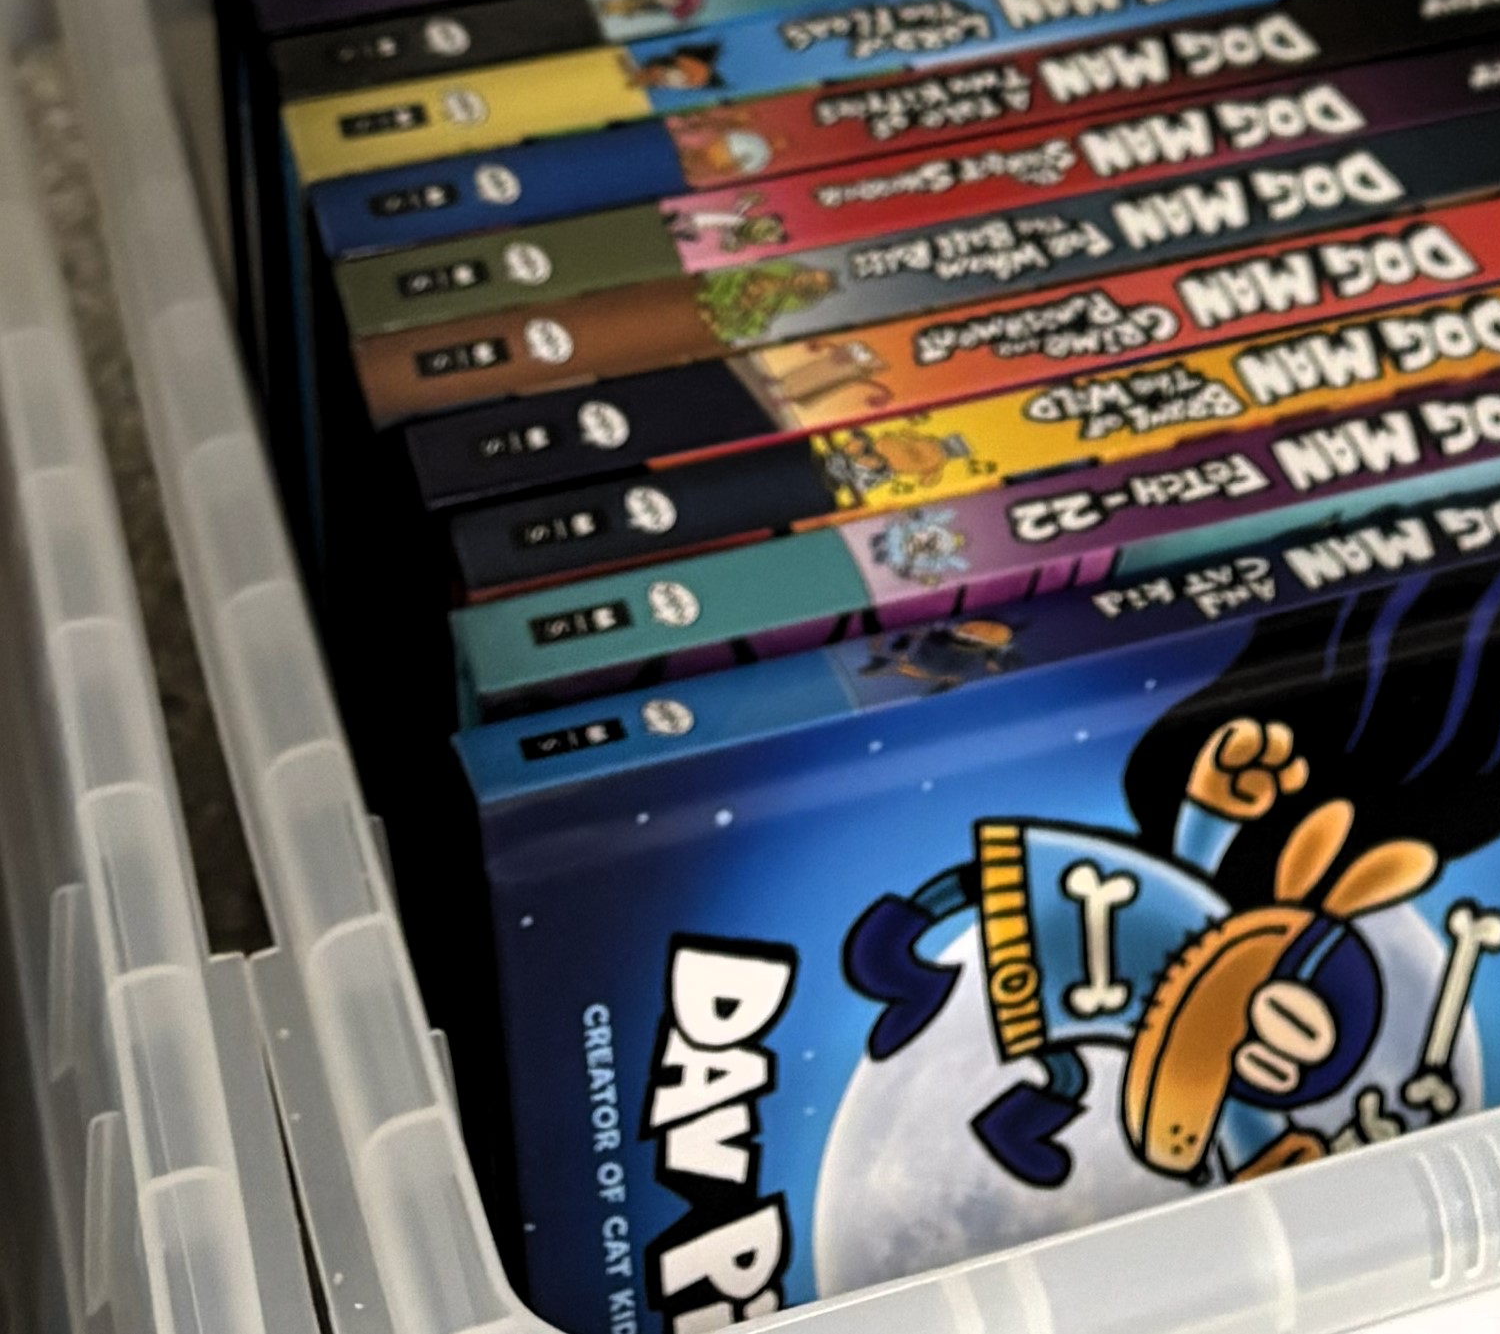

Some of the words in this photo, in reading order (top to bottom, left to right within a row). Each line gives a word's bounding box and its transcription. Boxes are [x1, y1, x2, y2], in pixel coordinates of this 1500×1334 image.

[1036, 37, 1171, 104] MAN
[1173, 12, 1322, 76] DOG
[1077, 109, 1216, 177] MAN
[1216, 82, 1368, 150] DOG
[1112, 177, 1250, 251] MAN
[1253, 149, 1406, 221] DOG
[1176, 249, 1322, 329] MAN
[1319, 222, 1483, 300] DOG
[1233, 324, 1379, 406] MAN
[1271, 410, 1422, 492] MAN
[1282, 517, 1437, 591] MAN
[582, 1002, 622, 1153] CREATOR
[649, 944, 793, 1185] DAV
[598, 1161, 626, 1204] OF
[603, 1215, 633, 1279] CAT
